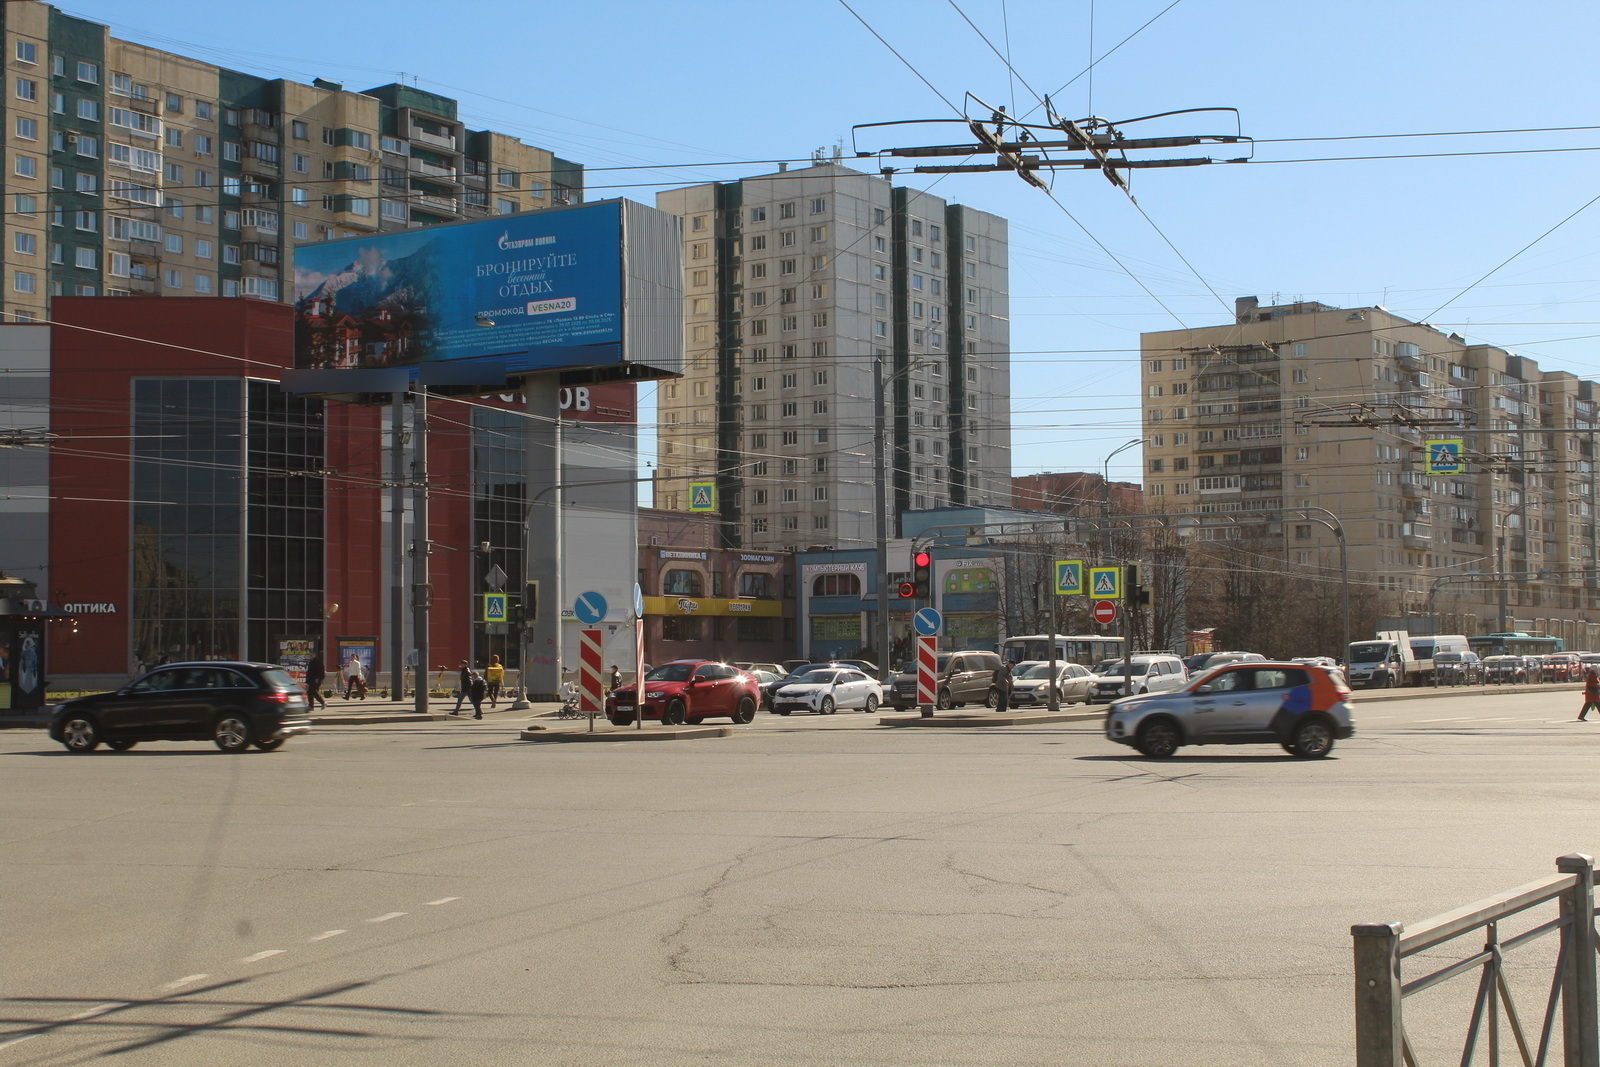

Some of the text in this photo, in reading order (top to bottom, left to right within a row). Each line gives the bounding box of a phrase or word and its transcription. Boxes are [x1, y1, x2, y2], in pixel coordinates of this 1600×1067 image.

[508, 238, 534, 249] ГАЗПРОМ
[477, 253, 577, 278] БРОНИРУЙТЕ
[507, 269, 547, 284] весенний
[499, 280, 553, 297] ОТДЫХ
[477, 306, 524, 317] ПРОМОКОД
[532, 300, 571, 312] VESNA20
[666, 551, 701, 559] ВЕТКЛИНИКА
[740, 554, 775, 563] ЗООМАГАЗИН
[806, 563, 865, 572] КОМПЬЮТЕРНЫЙ КЛУБ
[64, 603, 116, 613] ОПТИКА
